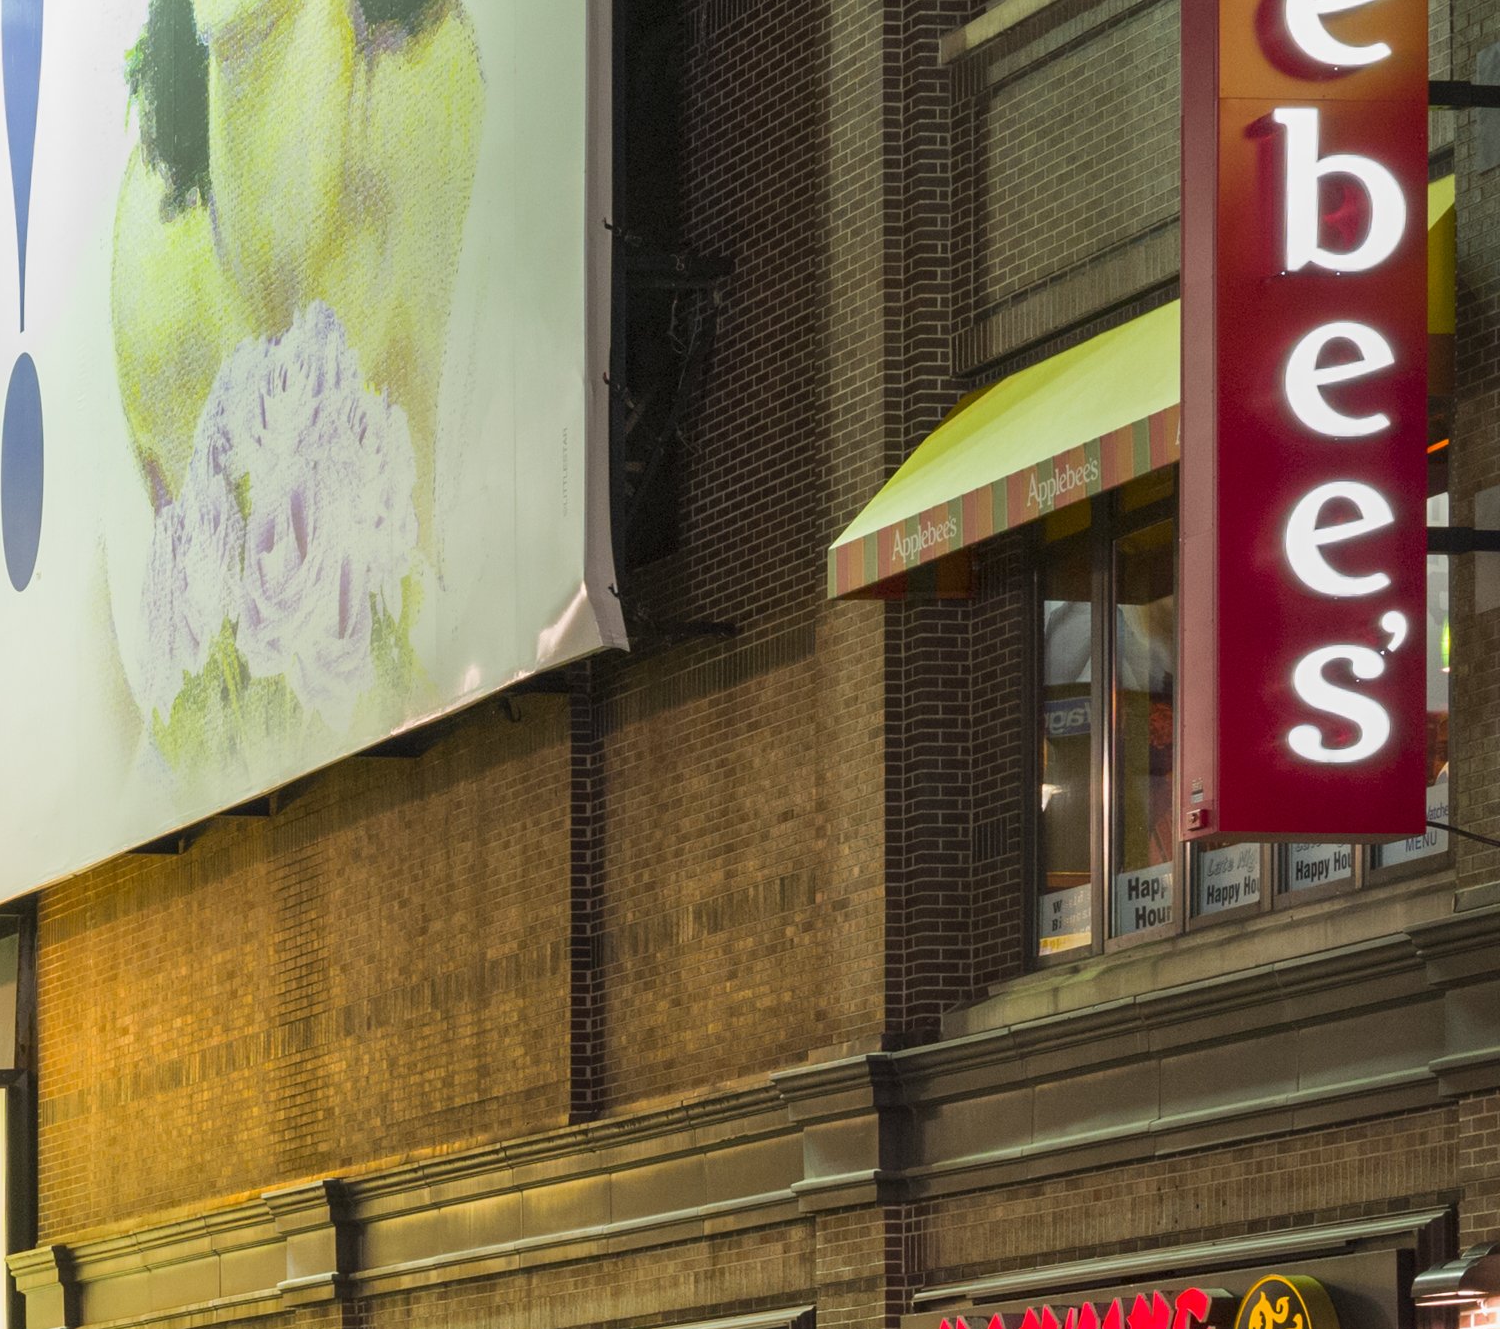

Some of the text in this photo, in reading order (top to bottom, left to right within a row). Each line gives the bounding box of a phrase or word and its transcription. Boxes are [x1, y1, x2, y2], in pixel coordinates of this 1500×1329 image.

[1026, 457, 1100, 509] Applebee's
[892, 515, 957, 563] Applebee's
[1296, 857, 1328, 883] Happy
[1206, 881, 1240, 907] Happy
